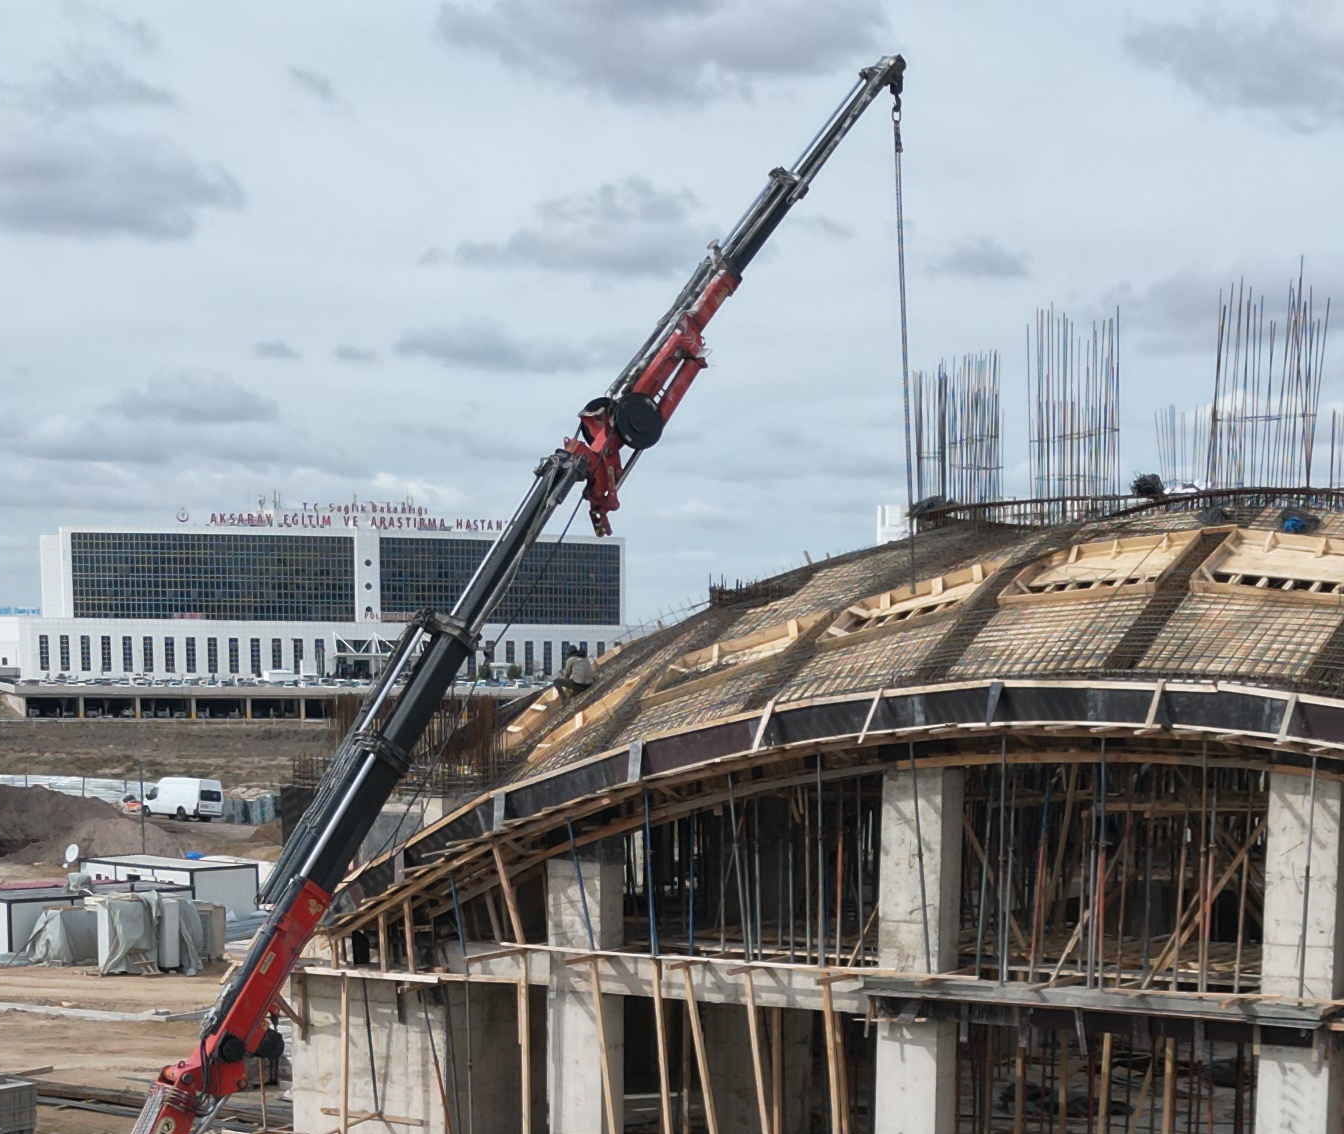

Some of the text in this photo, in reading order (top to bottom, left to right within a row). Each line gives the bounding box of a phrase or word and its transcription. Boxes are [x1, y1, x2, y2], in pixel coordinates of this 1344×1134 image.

[210, 511, 508, 531] AKSARAY EĞİTİM VE ARAŞTIRMA HASTAN
